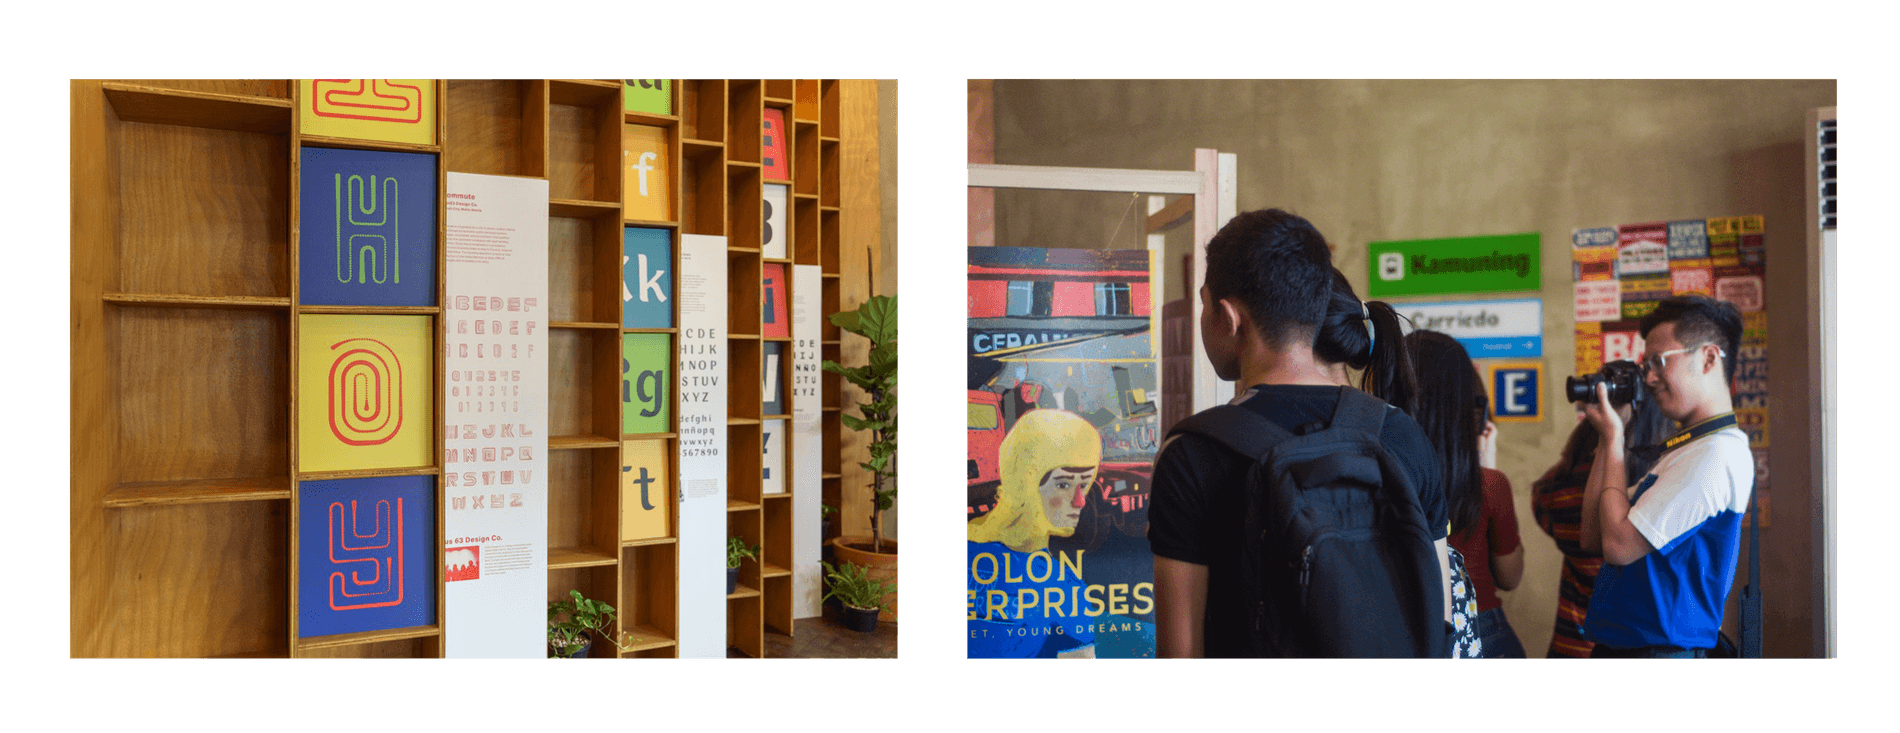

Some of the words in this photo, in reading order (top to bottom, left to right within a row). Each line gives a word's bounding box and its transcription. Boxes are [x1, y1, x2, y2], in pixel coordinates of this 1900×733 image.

[446, 192, 476, 200] ommute
[1504, 372, 1529, 412] E
[1666, 432, 1691, 448] Nikon
[465, 535, 490, 544] Design
[971, 549, 1086, 585] OLON
[1007, 625, 1064, 637] YOUNG
[1076, 622, 1142, 634] DREAMS
